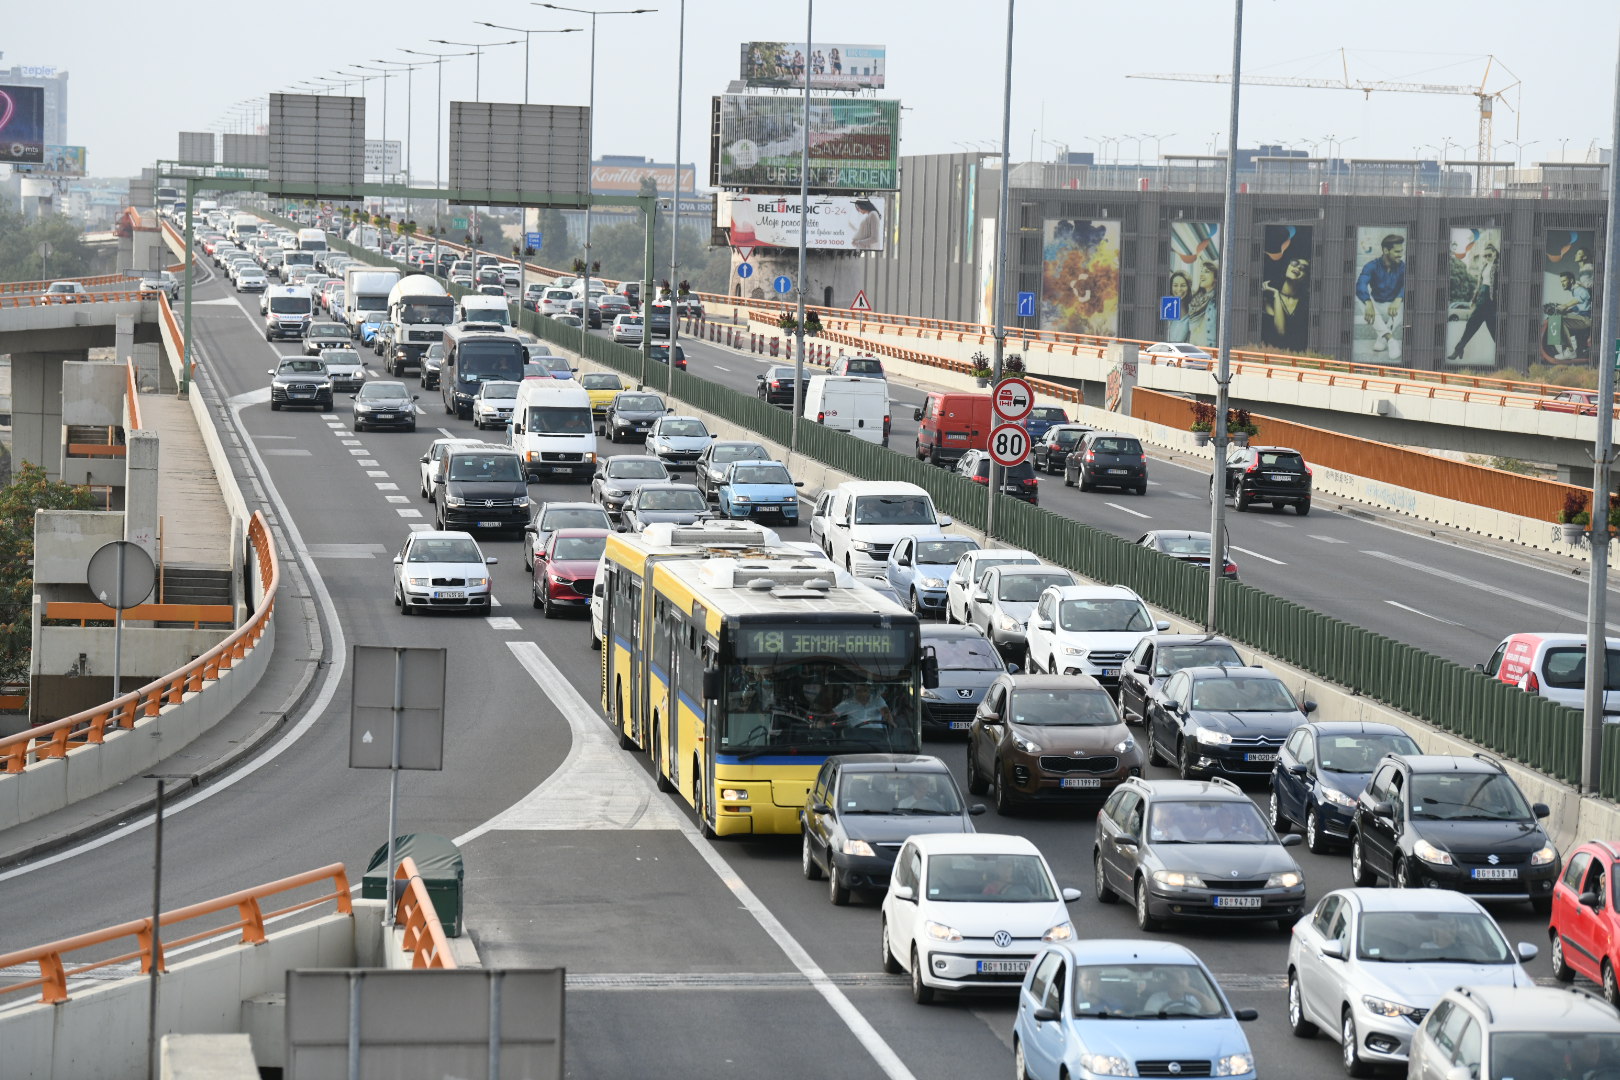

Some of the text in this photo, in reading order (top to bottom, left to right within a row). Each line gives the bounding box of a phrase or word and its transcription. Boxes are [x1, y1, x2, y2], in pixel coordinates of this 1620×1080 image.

[827, 168, 891, 185] GARDEN
[756, 216, 779, 228] Moje
[996, 433, 1023, 456] 80
[1476, 869, 1486, 878] BG
[1219, 897, 1229, 906] BG
[983, 962, 993, 971] BG
